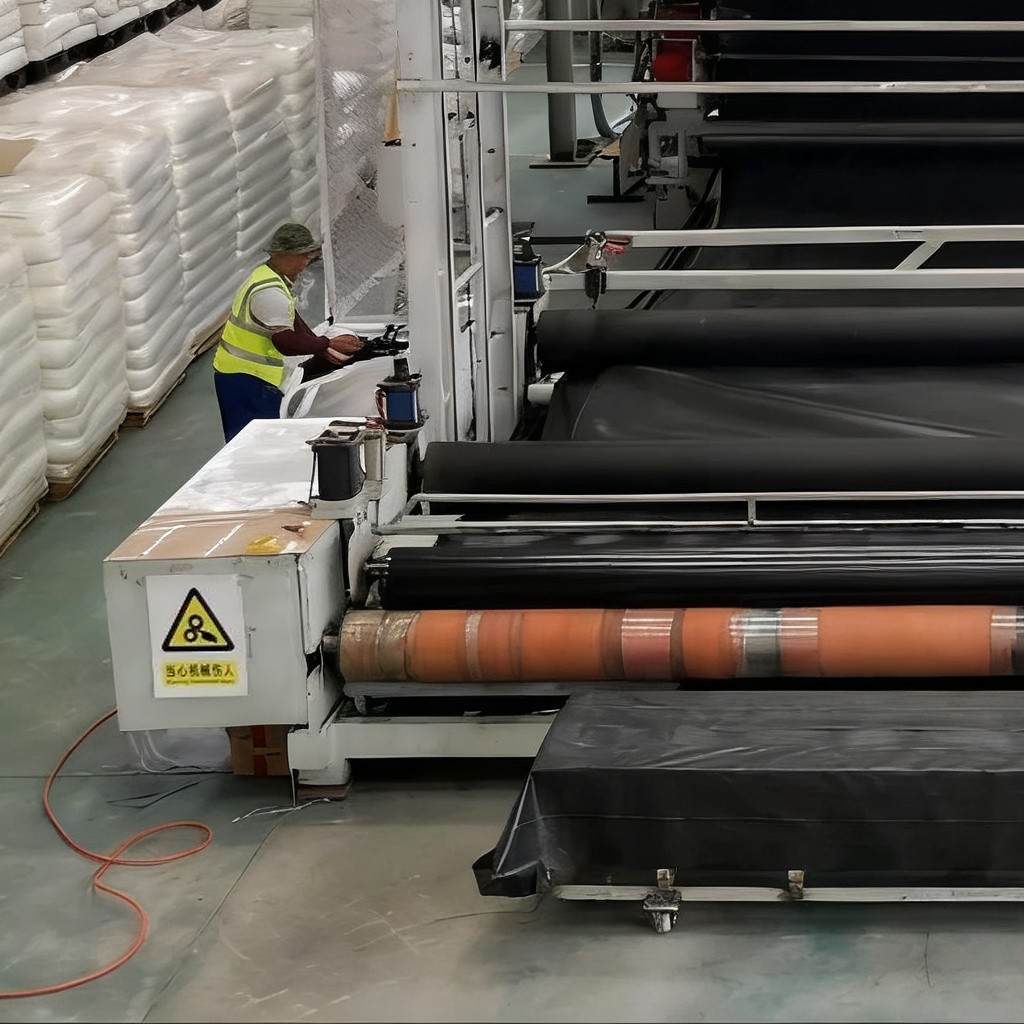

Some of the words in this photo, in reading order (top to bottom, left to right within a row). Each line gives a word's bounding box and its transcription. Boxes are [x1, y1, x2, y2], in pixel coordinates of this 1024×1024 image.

[167, 663, 234, 677] 当心机械伤人
